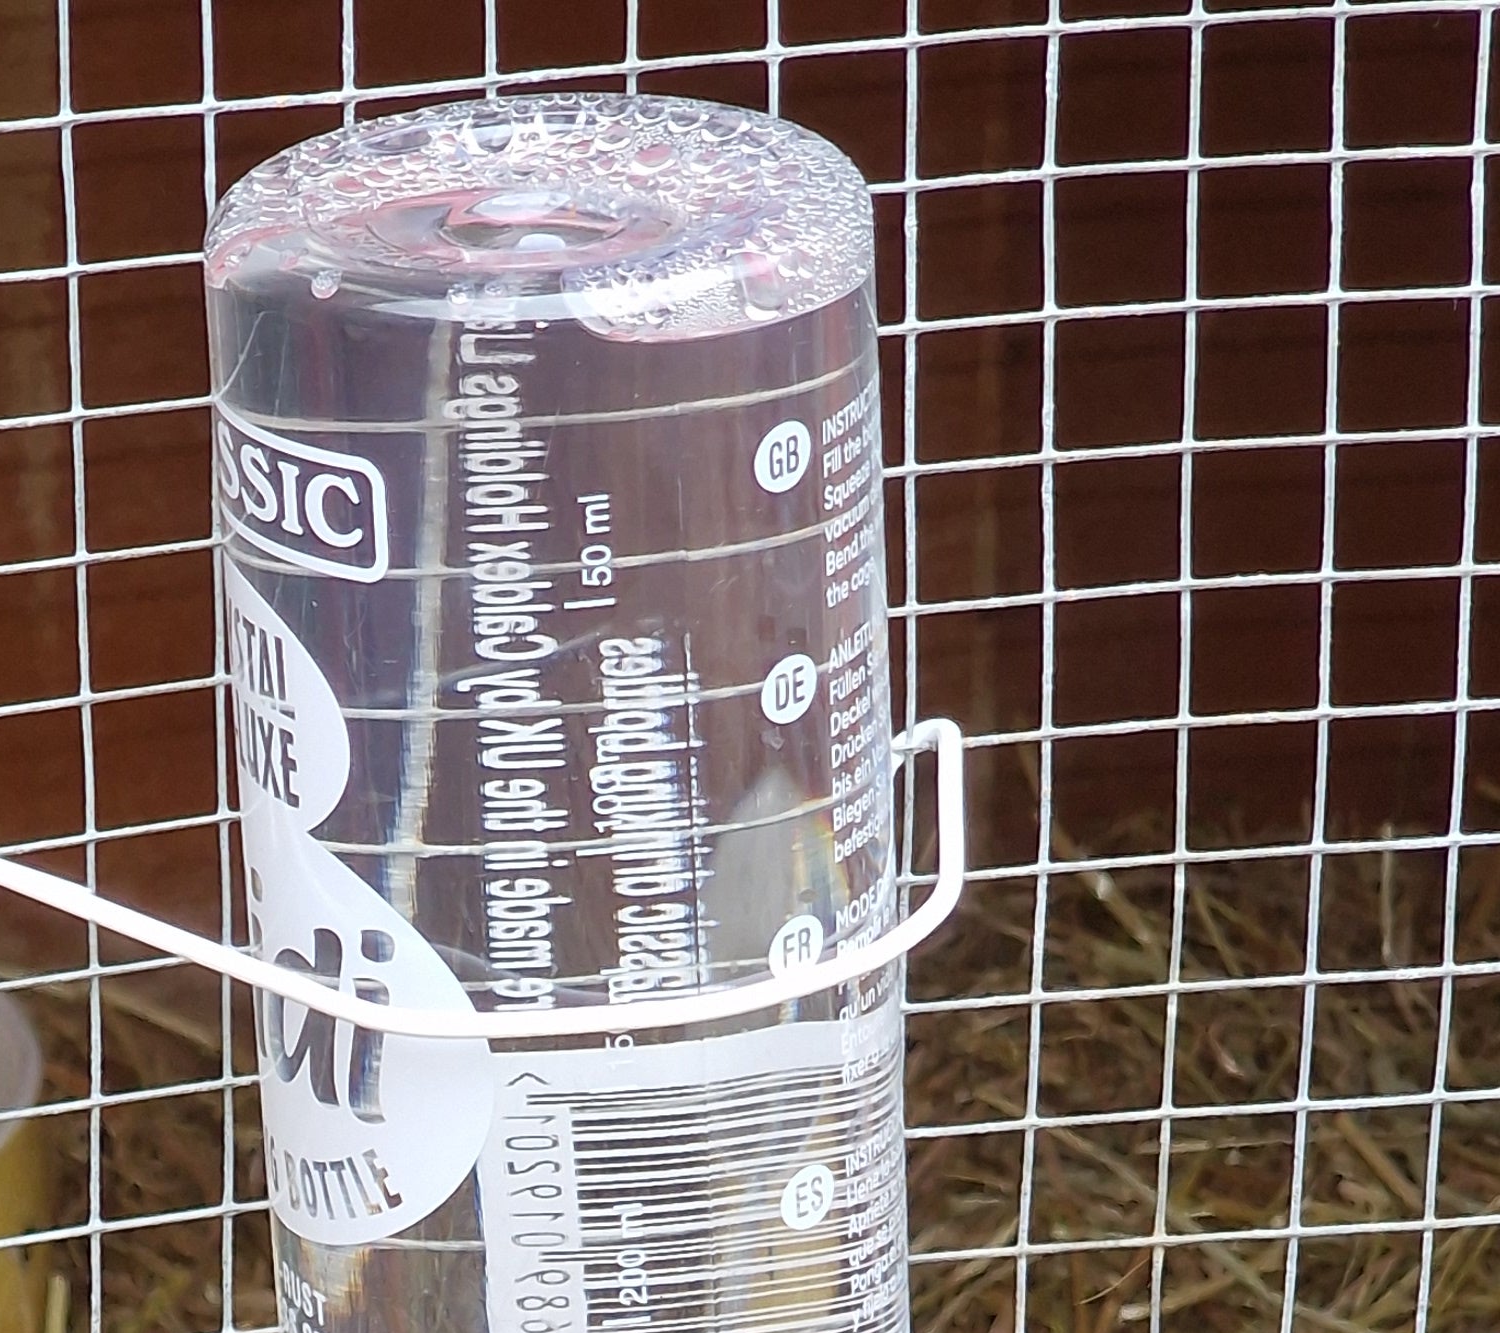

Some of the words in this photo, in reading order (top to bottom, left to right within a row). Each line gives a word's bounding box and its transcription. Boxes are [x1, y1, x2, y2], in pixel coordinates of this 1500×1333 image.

[769, 434, 799, 481] GB
[823, 443, 842, 479] Fill
[843, 436, 862, 464] the
[577, 494, 612, 535] ml
[824, 494, 870, 543] vacuum
[580, 544, 612, 587] 50
[826, 532, 859, 578] Bend
[825, 581, 850, 608] the
[774, 665, 806, 712] DE
[829, 665, 866, 705] Füllen
[830, 696, 871, 738] Deckel
[832, 770, 852, 801] bis
[853, 756, 871, 785] ein
[833, 787, 875, 833] Biegen
[783, 926, 811, 968] FR
[284, 1148, 403, 1220] BOTTLE
[796, 1175, 823, 1219] ES
[617, 1249, 648, 1306] 200
